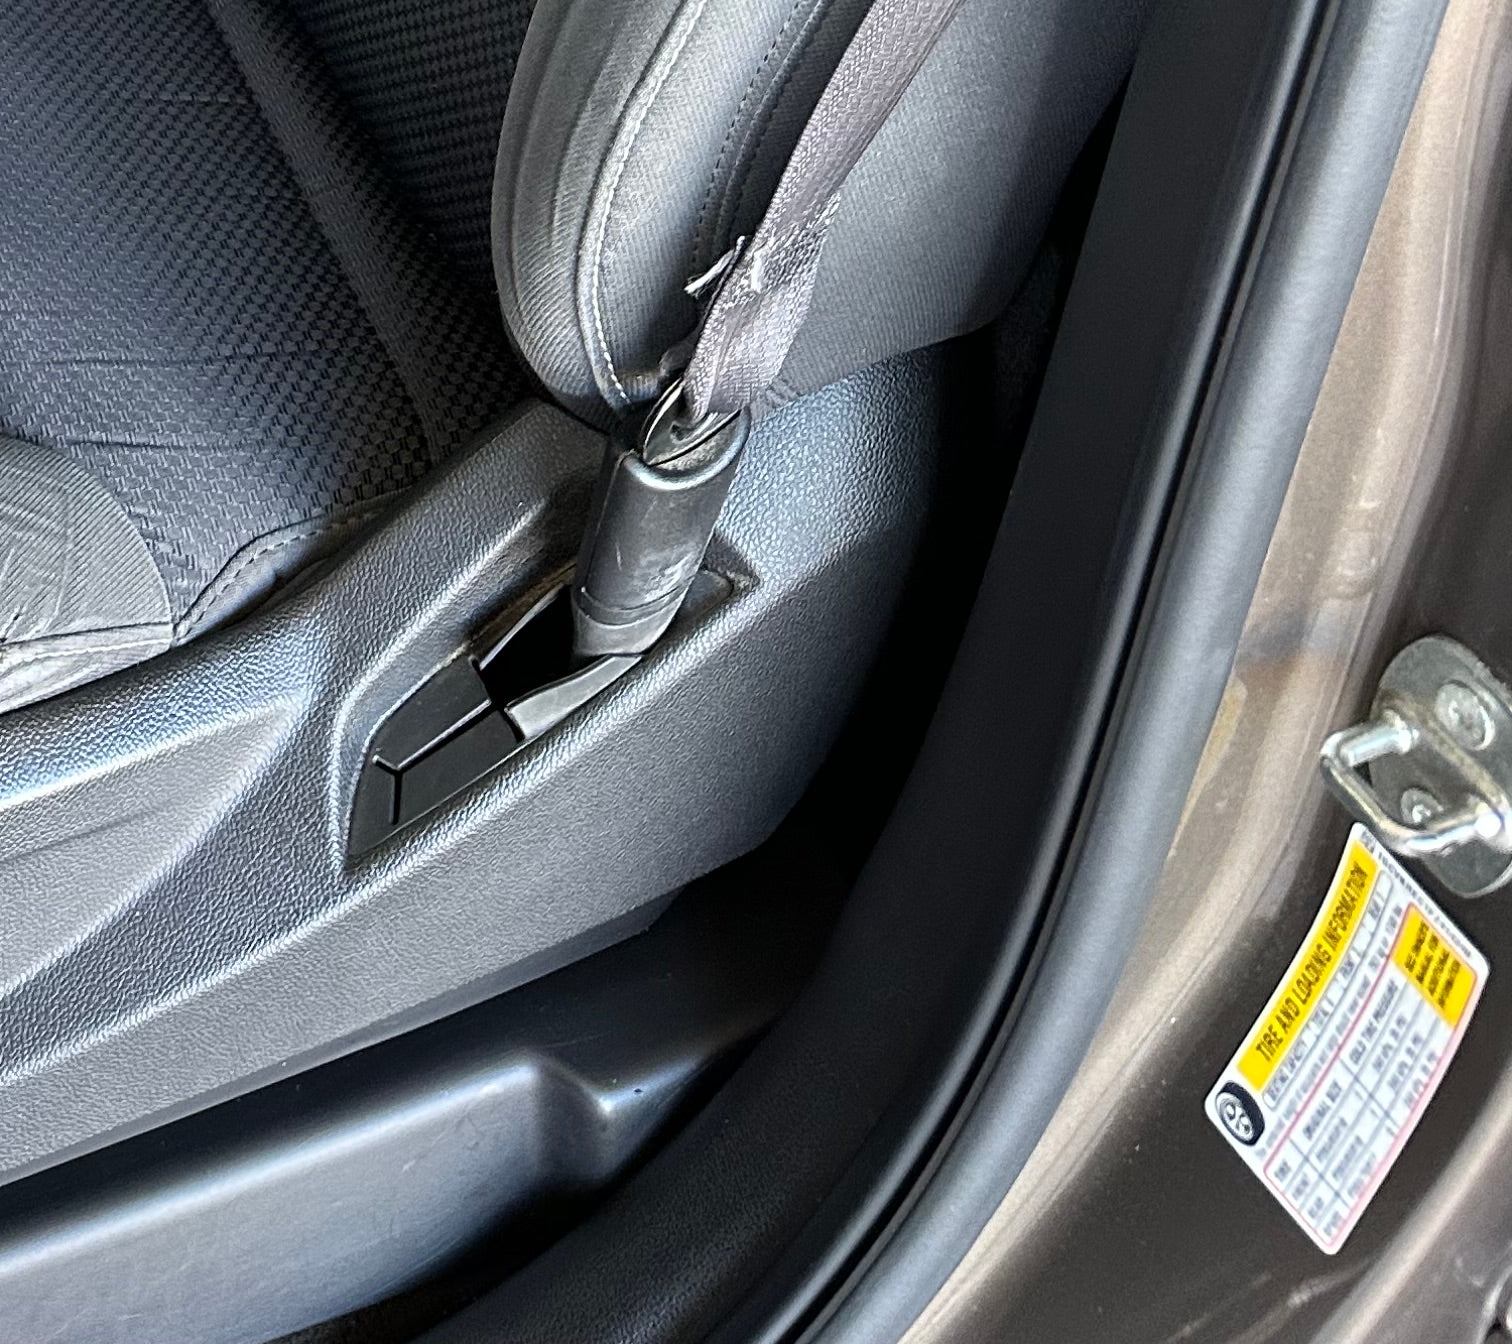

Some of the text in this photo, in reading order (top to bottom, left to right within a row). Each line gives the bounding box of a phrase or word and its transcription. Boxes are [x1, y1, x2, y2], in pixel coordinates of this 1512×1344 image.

[1255, 1024, 1284, 1063] TIRE
[1273, 995, 1301, 1034] AND
[1290, 940, 1331, 1005] LOADING
[1320, 861, 1368, 951] INFORMATION
